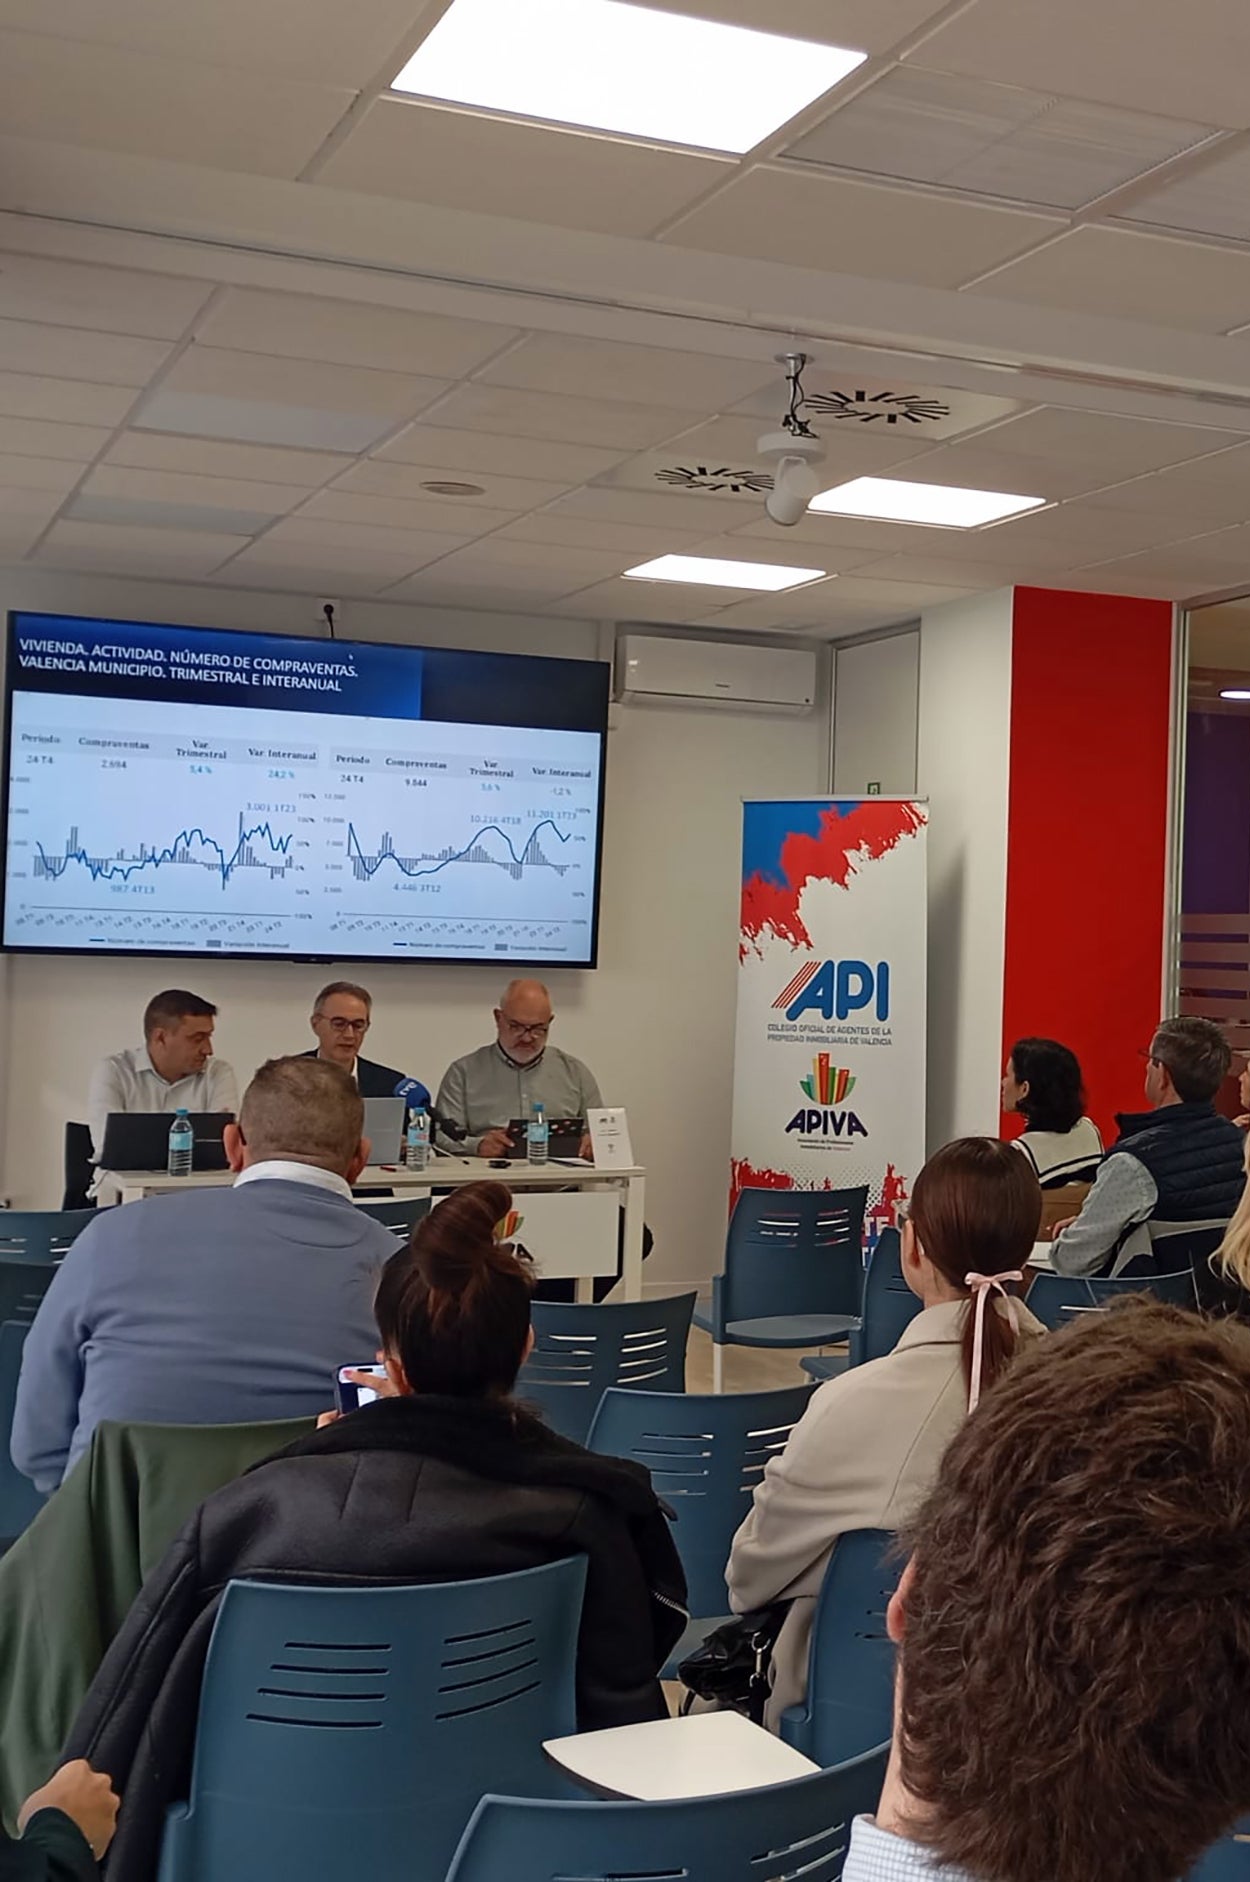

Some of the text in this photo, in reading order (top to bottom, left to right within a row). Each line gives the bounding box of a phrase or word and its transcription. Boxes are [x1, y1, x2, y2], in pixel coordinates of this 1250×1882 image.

[19, 638, 358, 677] VIVIENDA. ACTIVIDAD. NÚMERO DE COMPRAVENTAS.
[19, 655, 342, 692] VALENCIA MUNICIPIO. TRIMESTRAL E INTERANUAL
[176, 748, 227, 759] Trimestral
[469, 767, 515, 778] Trimestral
[786, 959, 890, 1022] API
[837, 1026, 870, 1035] AGENTES
[785, 1109, 868, 1137] APIVA
